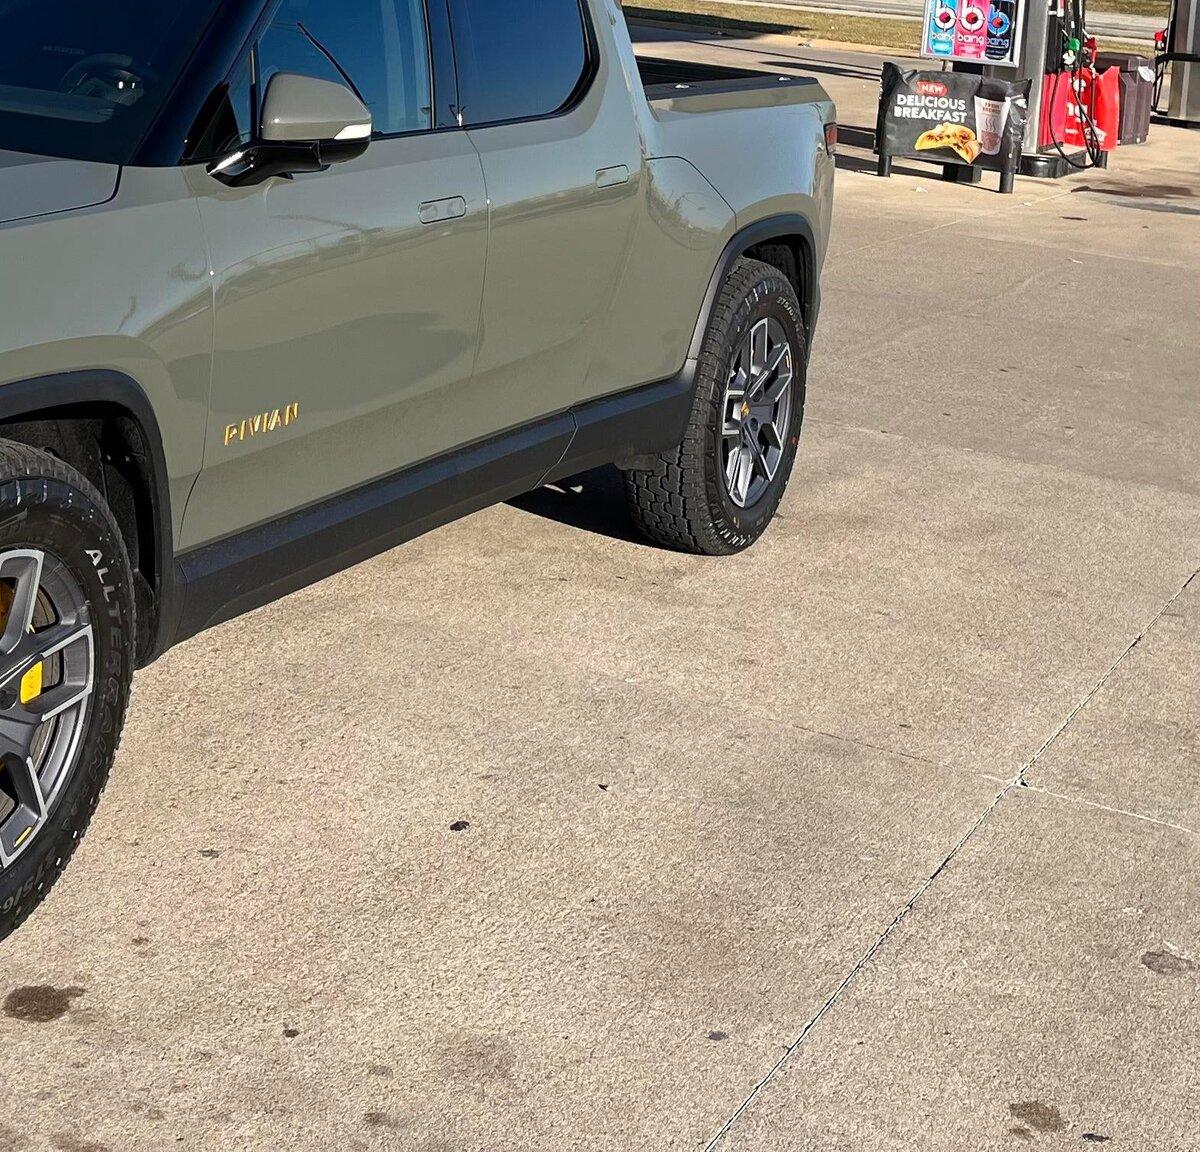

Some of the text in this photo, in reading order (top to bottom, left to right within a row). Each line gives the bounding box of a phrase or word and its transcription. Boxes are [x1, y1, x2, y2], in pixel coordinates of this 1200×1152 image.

[921, 83, 944, 93] NEW
[896, 94, 966, 111] DELICIOUS
[894, 106, 967, 123] BREAKFAST
[224, 402, 299, 446] RIVIAN
[83, 548, 115, 603] ALL
